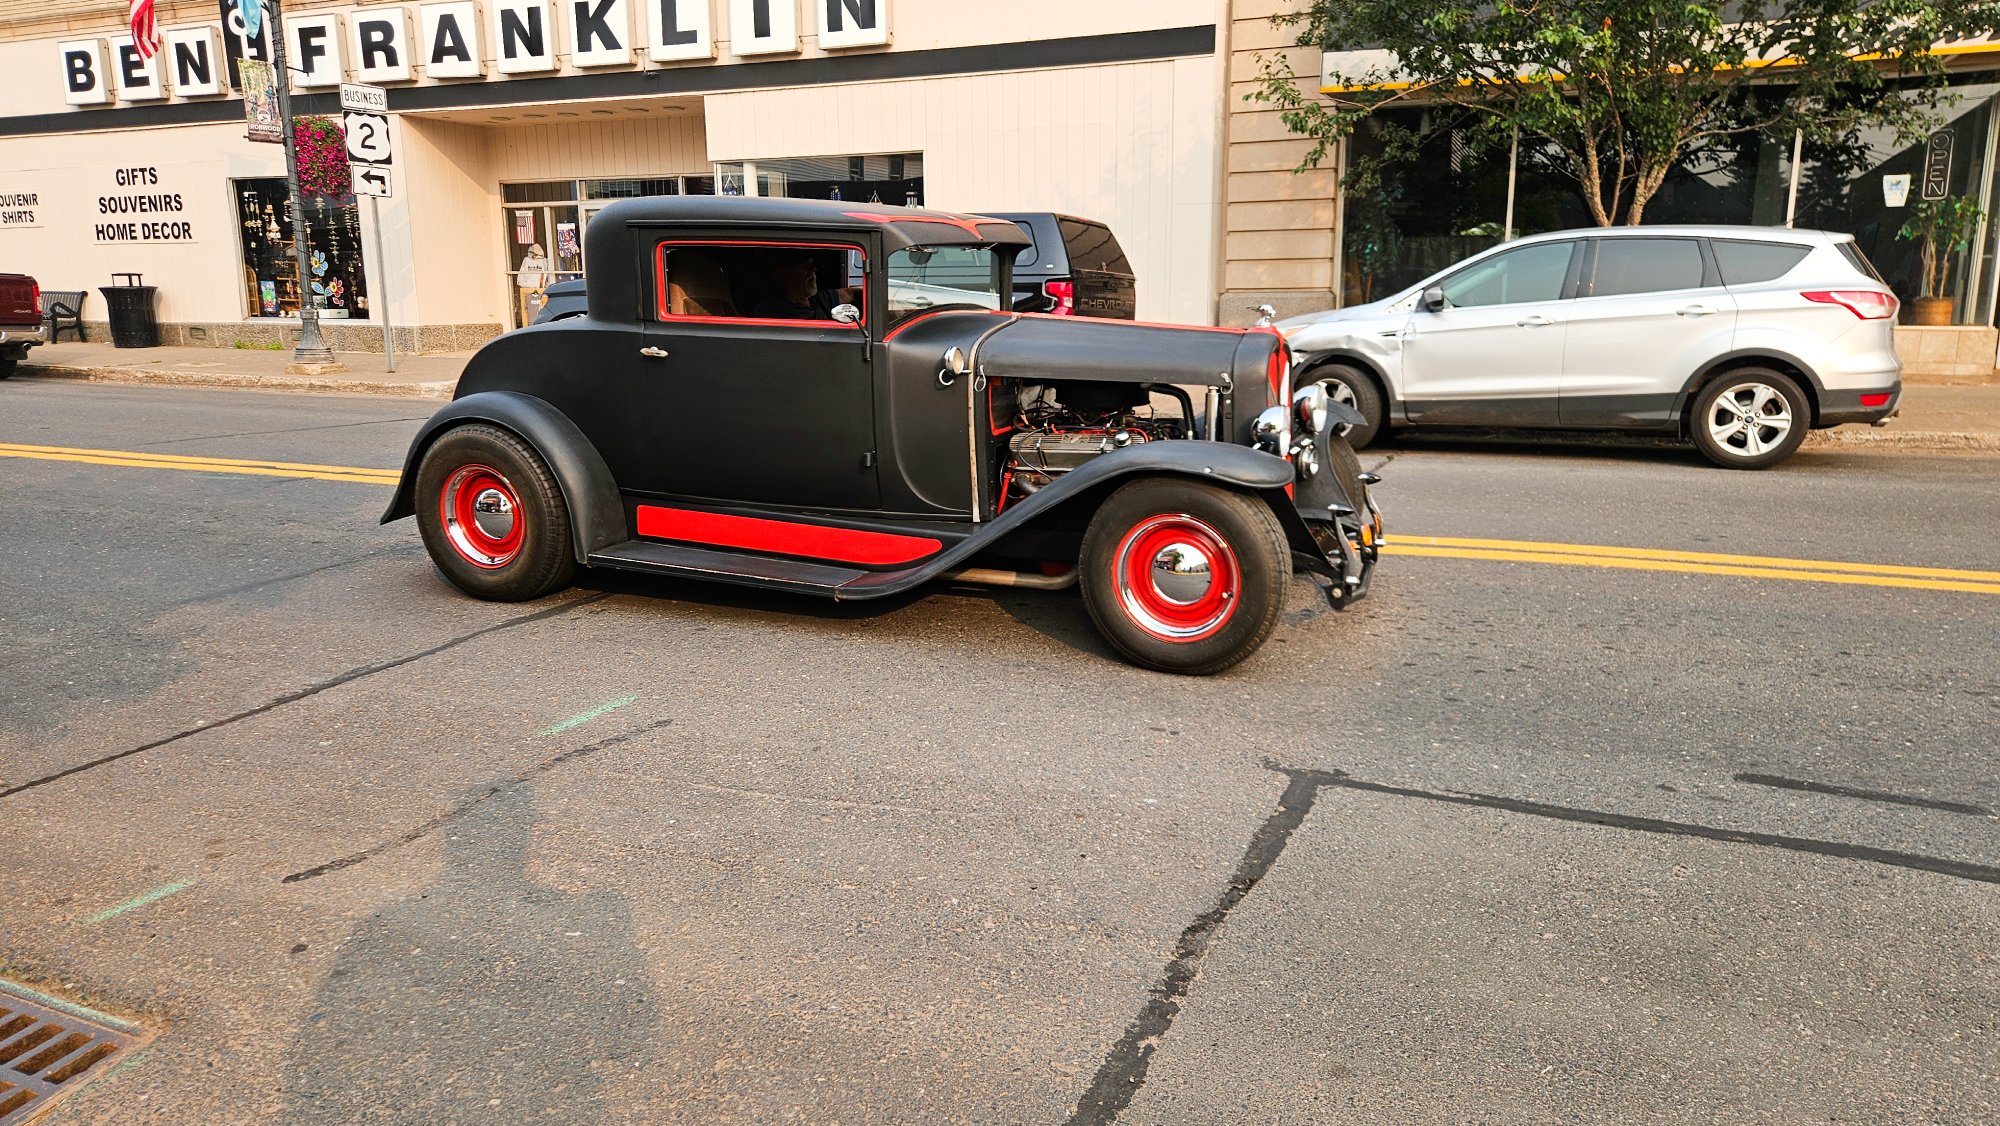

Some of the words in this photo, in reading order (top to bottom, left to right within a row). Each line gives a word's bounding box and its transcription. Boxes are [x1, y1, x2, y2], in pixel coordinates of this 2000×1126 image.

[65, 40, 211, 92] BEN
[298, 0, 876, 74] FRANKLIN
[344, 89, 384, 106] BUSINESS
[249, 123, 281, 132] IRONWOOD
[359, 122, 377, 150] 2
[1928, 133, 1949, 195] OPEN
[115, 167, 158, 186] GIFTS
[0, 193, 39, 207] OUVENIR
[98, 194, 183, 214] SOUVENIRS
[2, 211, 35, 224] SHIRTS
[95, 223, 138, 240] HOME
[142, 222, 192, 240] DECOR
[1081, 299, 1134, 310] CHEVROLET
